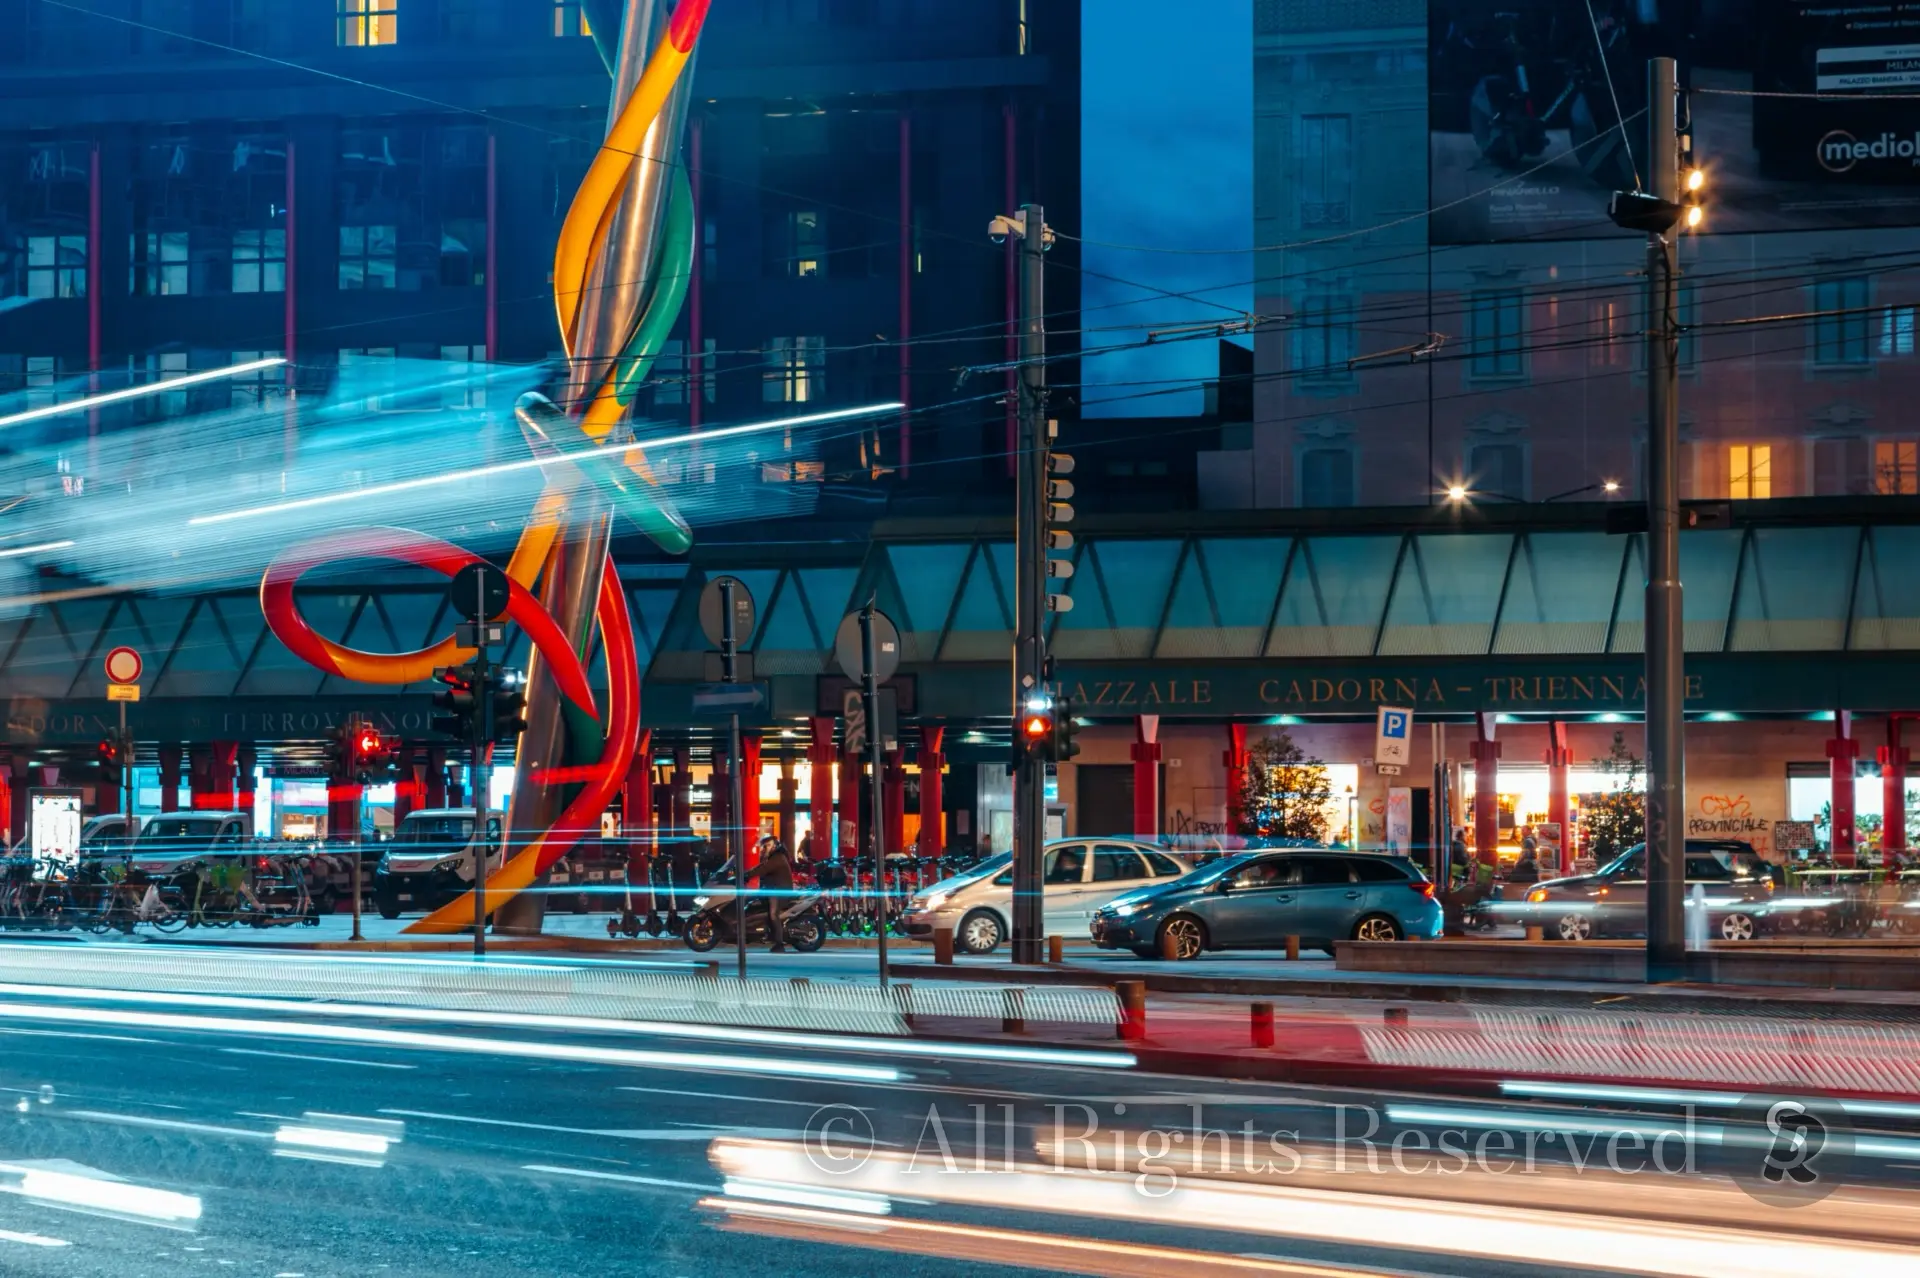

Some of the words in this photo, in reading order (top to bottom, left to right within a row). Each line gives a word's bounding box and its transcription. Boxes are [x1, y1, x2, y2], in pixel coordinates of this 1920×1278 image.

[1056, 679, 1212, 704] IAZZALE
[1260, 677, 1444, 703] CADORNA
[1484, 675, 1704, 702] TRIENNAE
[1689, 818, 1769, 836] PROVINCIALE
